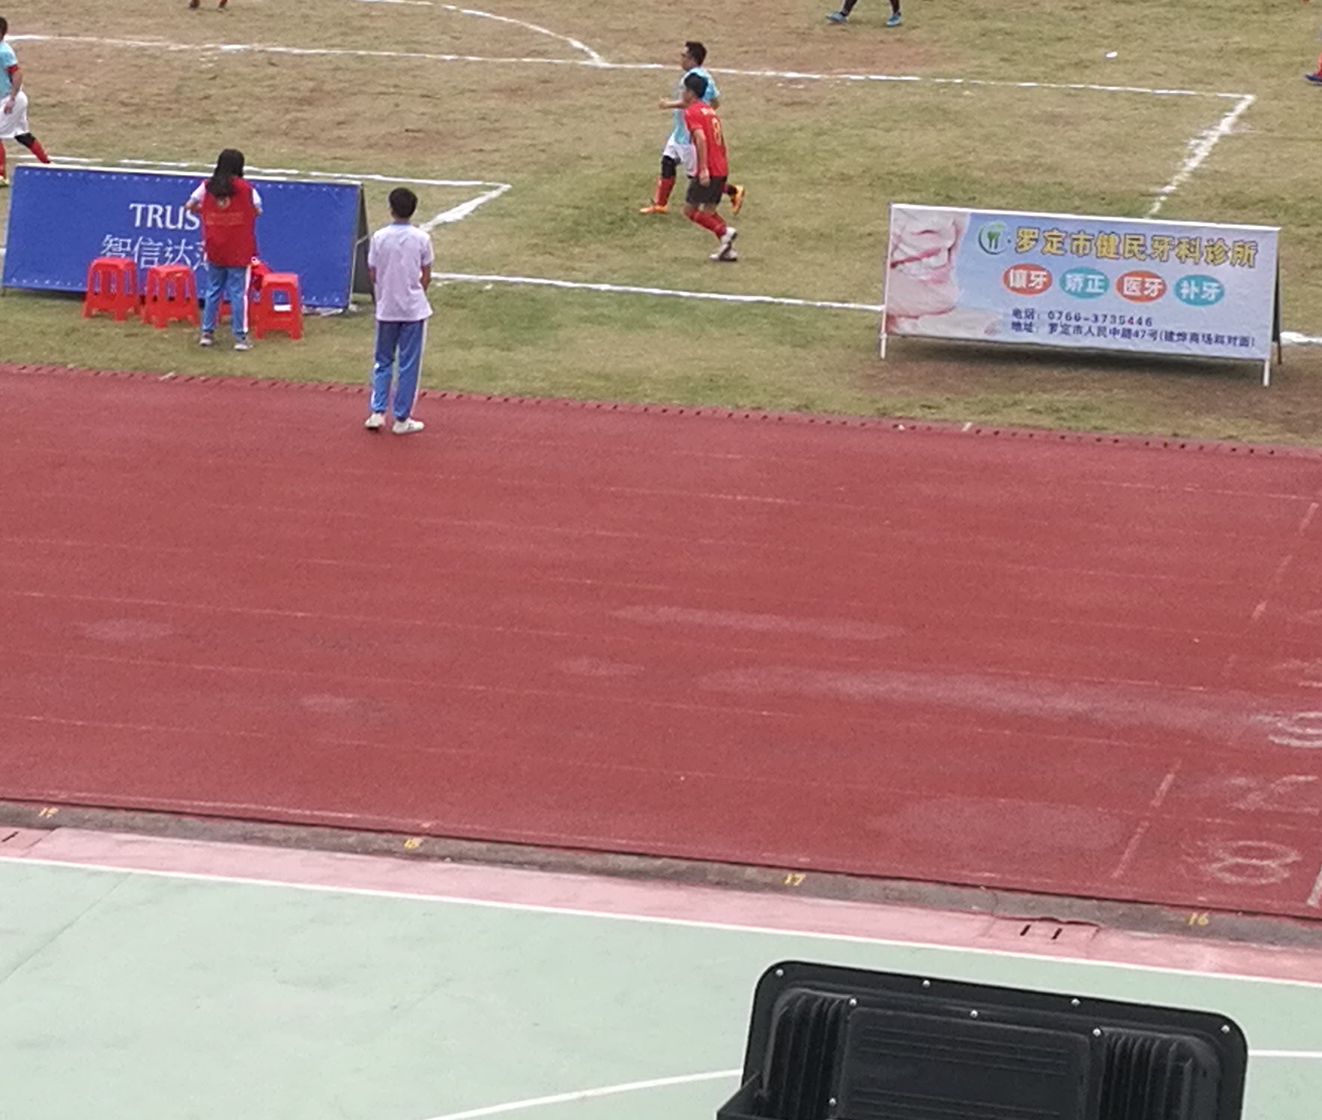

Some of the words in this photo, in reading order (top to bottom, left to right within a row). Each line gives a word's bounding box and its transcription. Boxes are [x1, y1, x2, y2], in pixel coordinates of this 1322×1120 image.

[129, 203, 200, 231] TRUS
[1015, 226, 1259, 267] 罗定市健民牙科诊所
[1122, 276, 1164, 298] 医牙
[1180, 280, 1221, 301] 补牙
[784, 873, 806, 886] 17
[1188, 911, 1209, 926] 16
